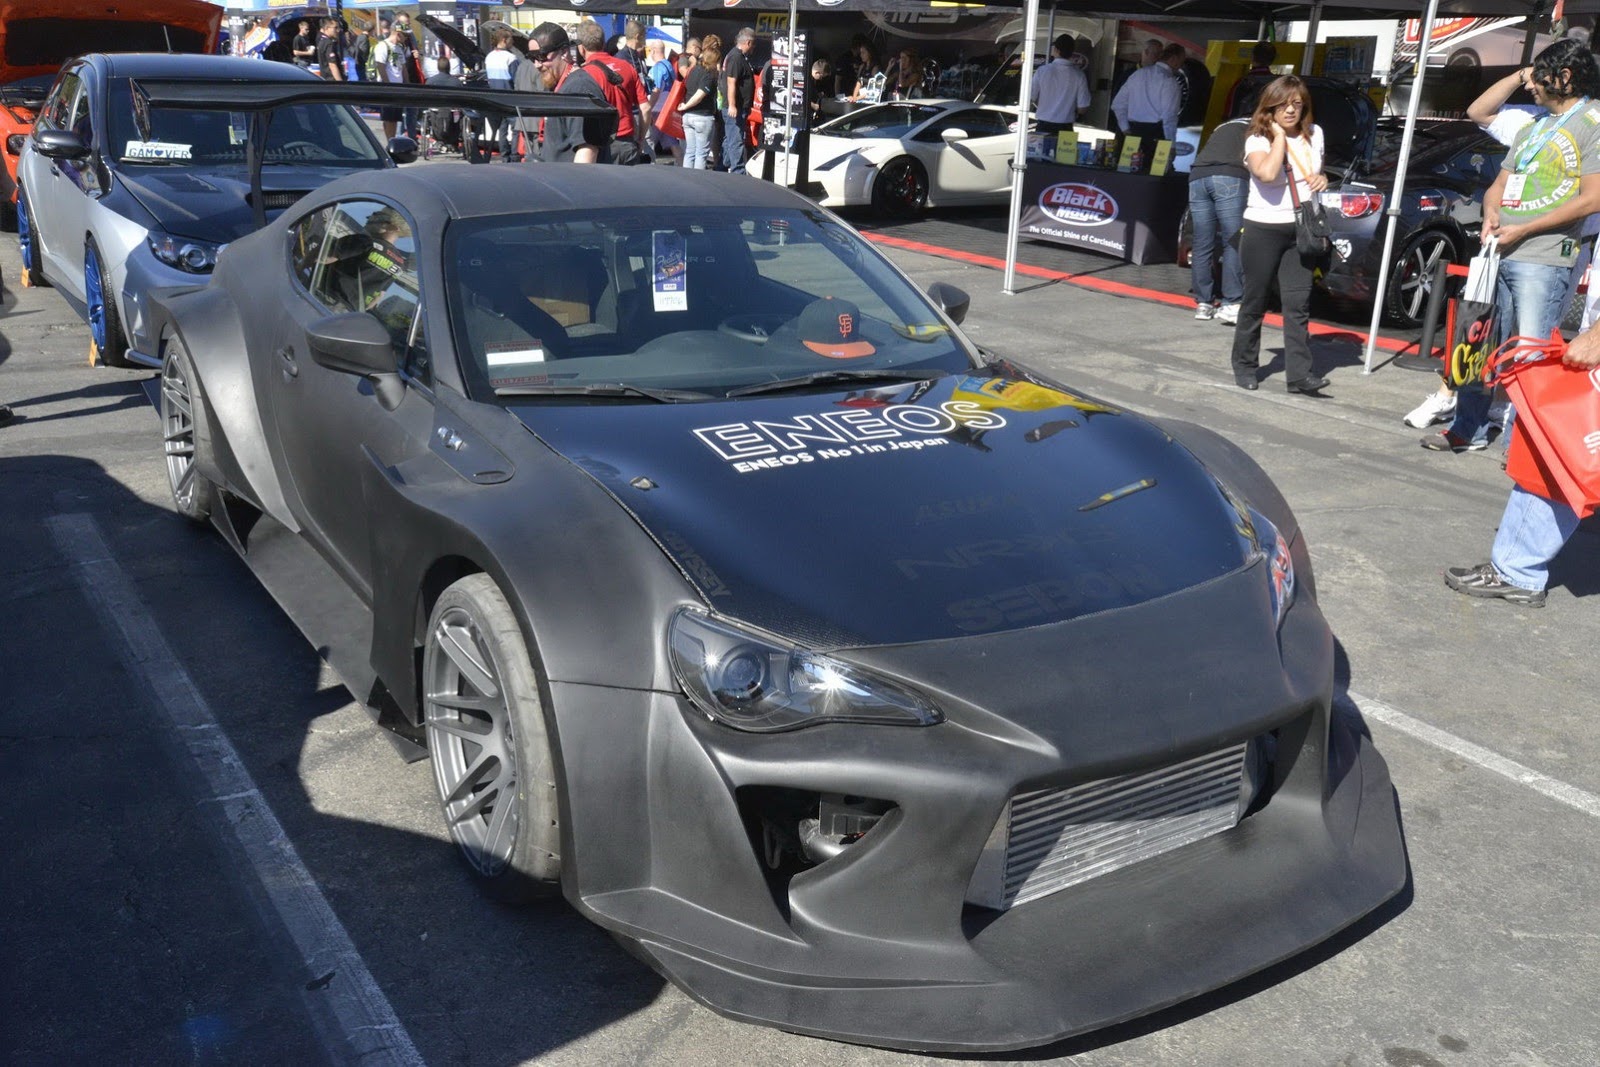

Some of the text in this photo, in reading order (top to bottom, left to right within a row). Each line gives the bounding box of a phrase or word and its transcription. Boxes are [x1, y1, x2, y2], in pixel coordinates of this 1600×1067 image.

[1051, 188, 1108, 210] Black
[1056, 206, 1103, 222] Magic
[1041, 227, 1063, 237] Official
[1064, 230, 1080, 240] Shine
[693, 401, 1006, 460] ENEOS
[733, 452, 814, 473] ENEOS
[888, 437, 949, 451] Japan
